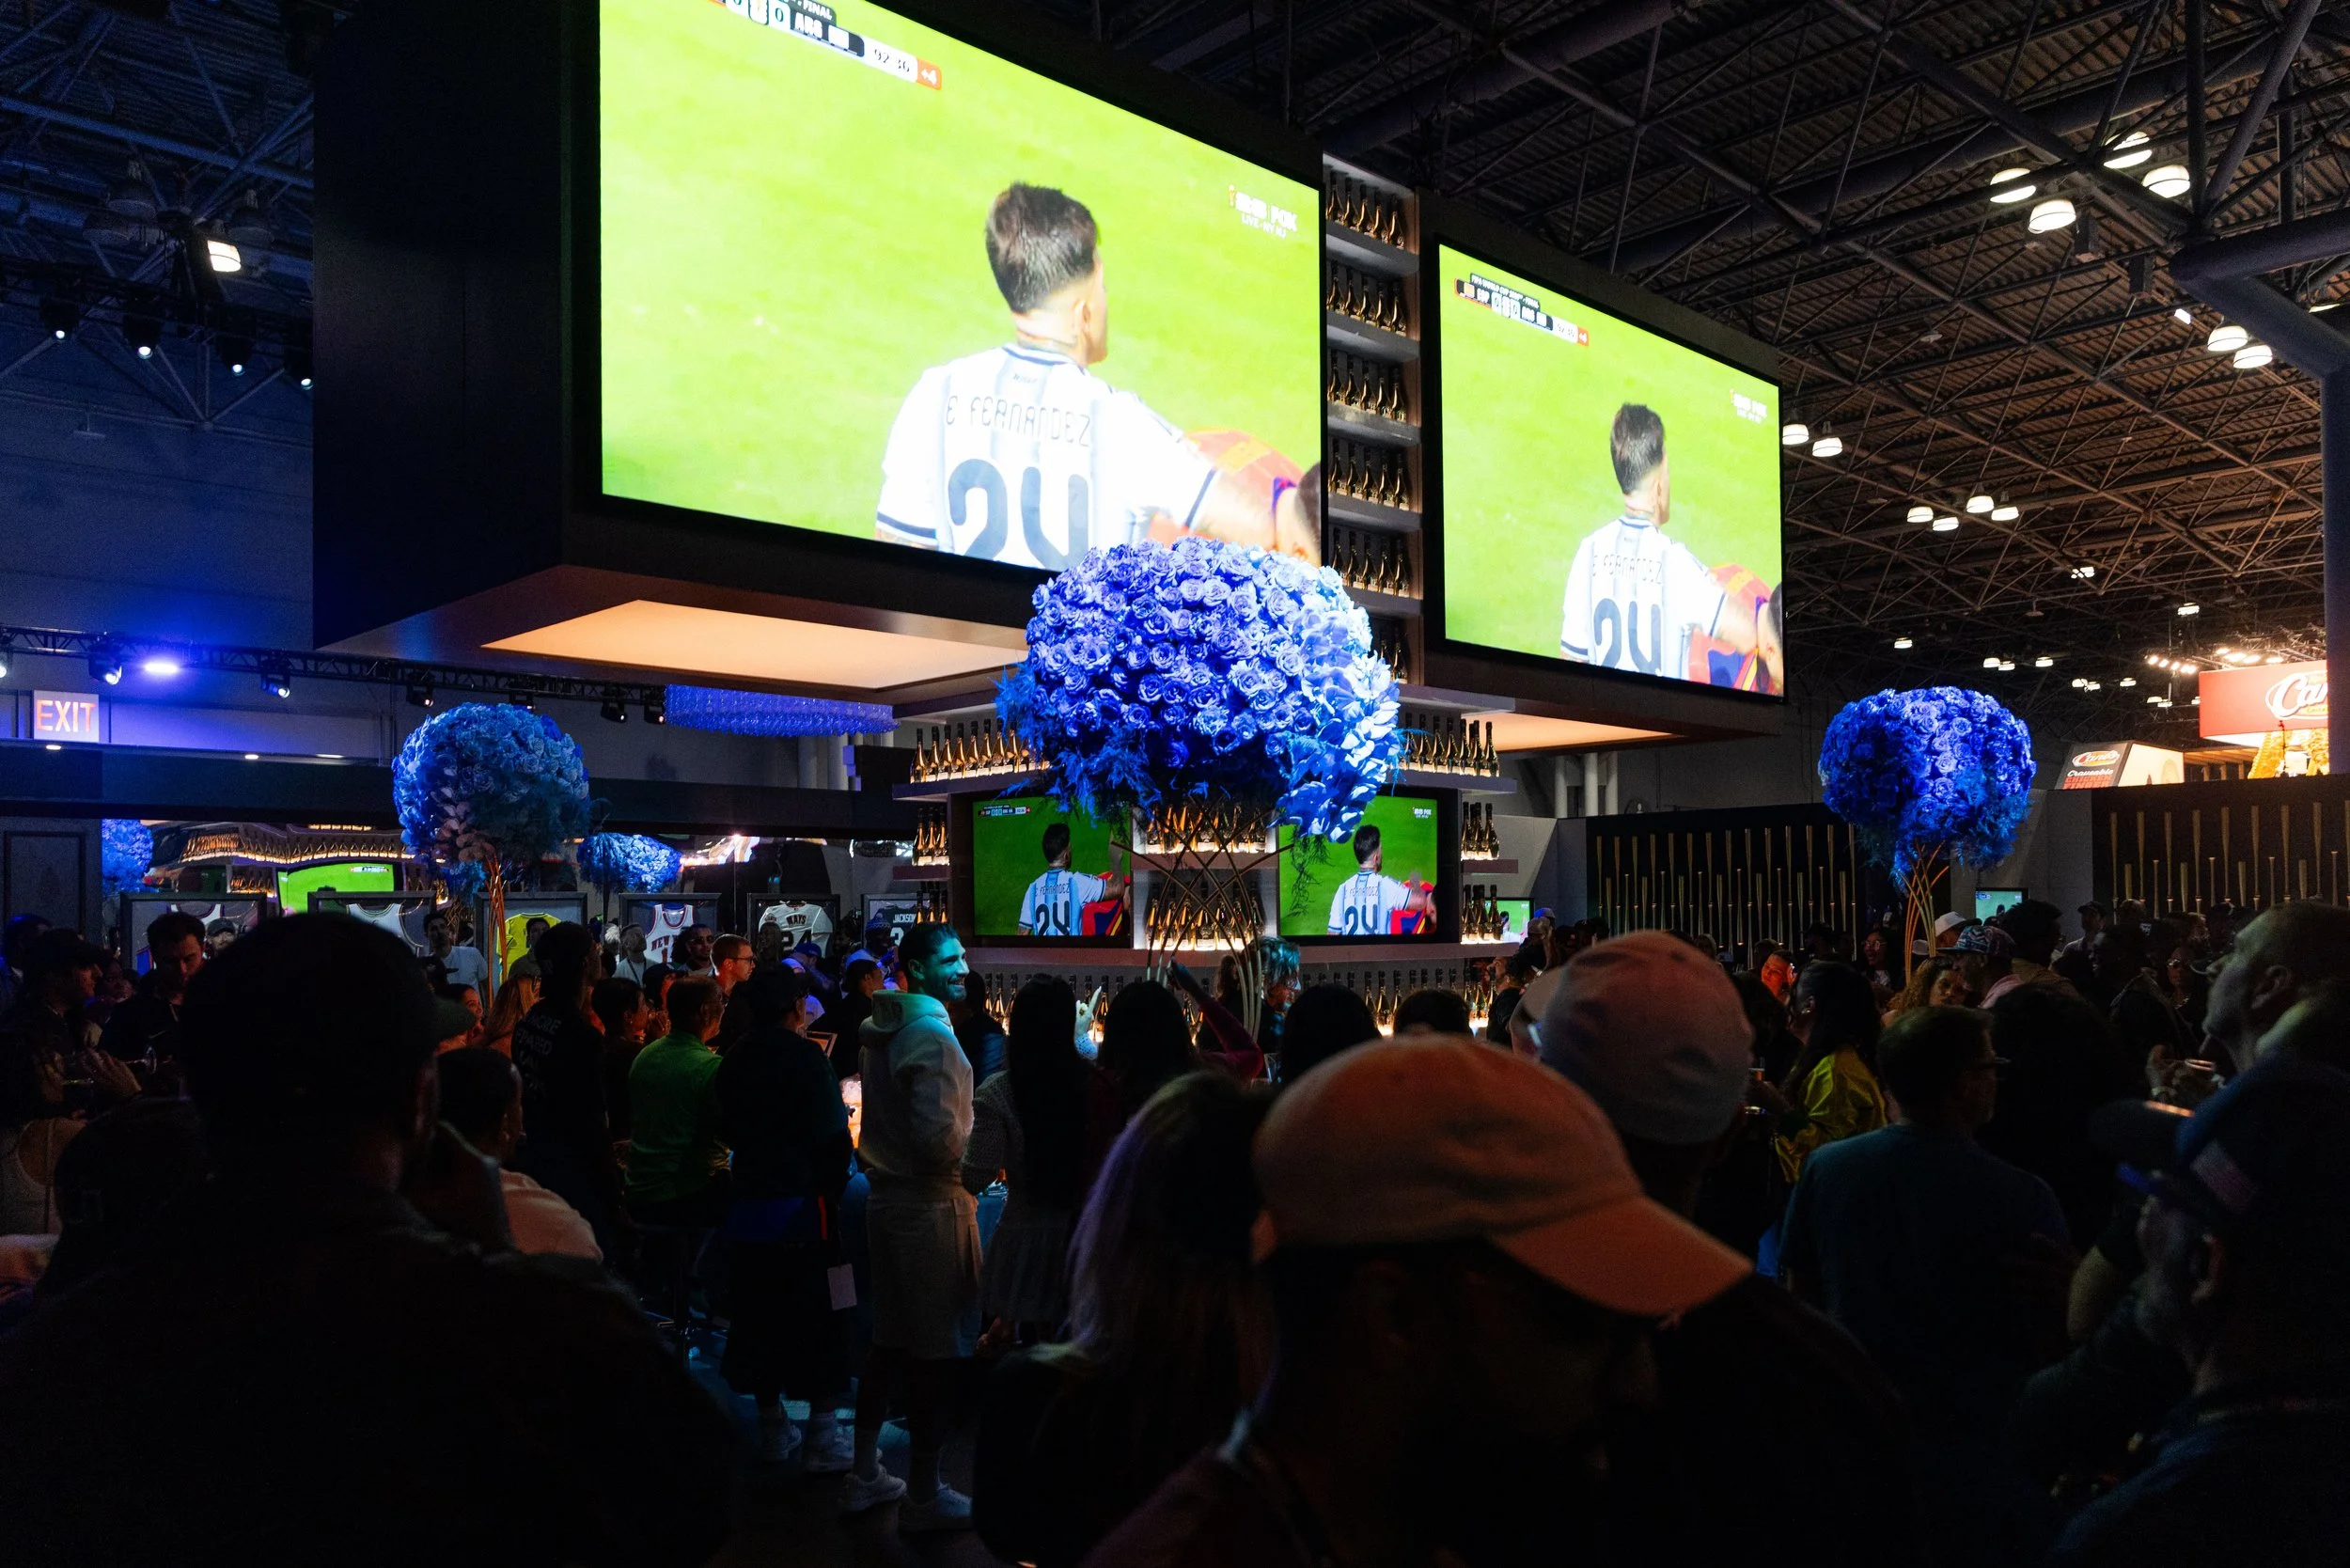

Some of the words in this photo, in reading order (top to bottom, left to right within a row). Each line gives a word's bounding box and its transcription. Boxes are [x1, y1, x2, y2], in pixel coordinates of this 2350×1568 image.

[970, 396, 1091, 447] FERNANDEZ
[36, 699, 97, 732] EXIT
[786, 914, 807, 926] MAYS
